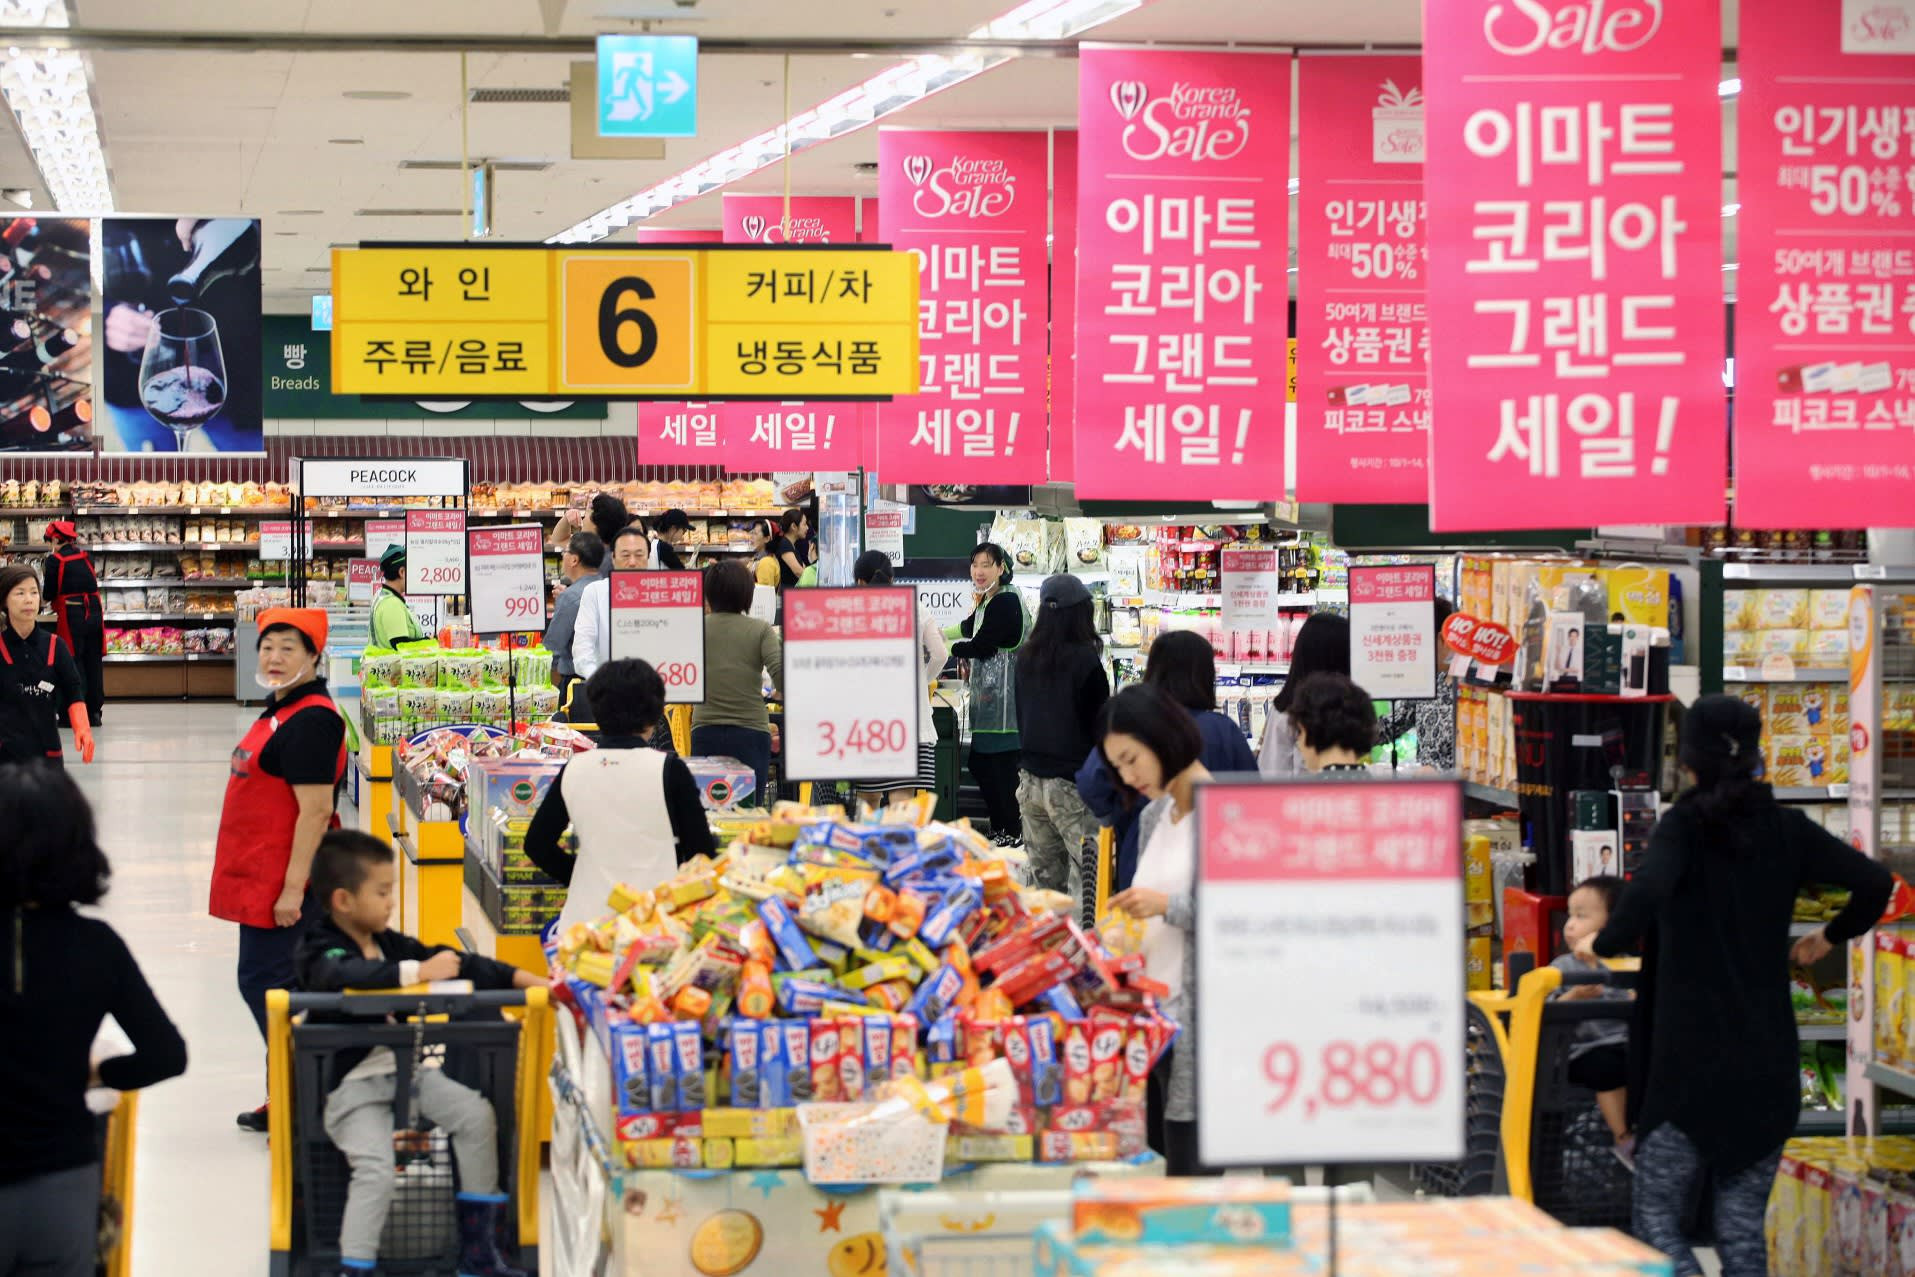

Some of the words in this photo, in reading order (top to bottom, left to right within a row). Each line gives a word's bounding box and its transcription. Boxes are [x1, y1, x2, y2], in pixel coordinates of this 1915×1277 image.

[1483, 0, 1663, 55] Sale
[1170, 82, 1236, 104] Korea
[1175, 99, 1241, 120] Grand
[1122, 97, 1251, 161] Sale
[1463, 102, 1685, 186] 이마트
[951, 155, 1004, 172] Korea
[955, 168, 1008, 185] Grand
[913, 168, 1016, 218] Sale
[1105, 195, 1261, 255] 이마트
[1325, 200, 1427, 238] 인기생
[1465, 196, 1686, 280] 코리아
[907, 245, 1026, 292] 이마트
[1775, 249, 1845, 277] 50여개
[1849, 249, 1915, 278] 브랜드
[745, 269, 873, 304] 커피/차
[1104, 264, 1262, 324] 코리아
[598, 275, 658, 368] 6
[919, 299, 1027, 345] 코리아
[1325, 303, 1376, 322] 50여개
[1380, 303, 1428, 323] 브랜드
[1769, 283, 1893, 335] 상품권
[1321, 327, 1412, 364] 상품권
[1467, 294, 1686, 378] 그랜드
[283, 343, 307, 370] 빵
[363, 339, 528, 375] 주류/음료
[737, 341, 882, 376] 냉동식품
[1103, 334, 1258, 394] 그랜드
[270, 374, 320, 391] Breads
[919, 352, 1025, 401] 그랜드
[659, 414, 725, 447] 세일
[750, 413, 836, 451] 세일!
[909, 408, 1020, 457] 세일!
[1324, 409, 1387, 435] 피코크
[1772, 397, 1859, 434] 피코크
[1114, 403, 1252, 464] 세일!
[1487, 392, 1680, 478] 세일!
[350, 470, 417, 483] PEACOCK
[352, 564, 381, 574] PEAC
[420, 567, 461, 585] 2,800
[640, 577, 668, 589] 이마트
[670, 577, 698, 589] 코리아
[505, 596, 539, 617] 990
[640, 591, 670, 604] 그랜드
[671, 590, 697, 603] 세일!
[920, 592, 962, 608] COCK
[1362, 633, 1422, 647] 신세계상품권
[1448, 616, 1473, 635] HO
[1473, 626, 1510, 649] HOT!
[1397, 649, 1417, 662] 증정
[655, 662, 697, 686] 680
[816, 719, 906, 760] 3,480
[1261, 1040, 1443, 1120] 9,880
